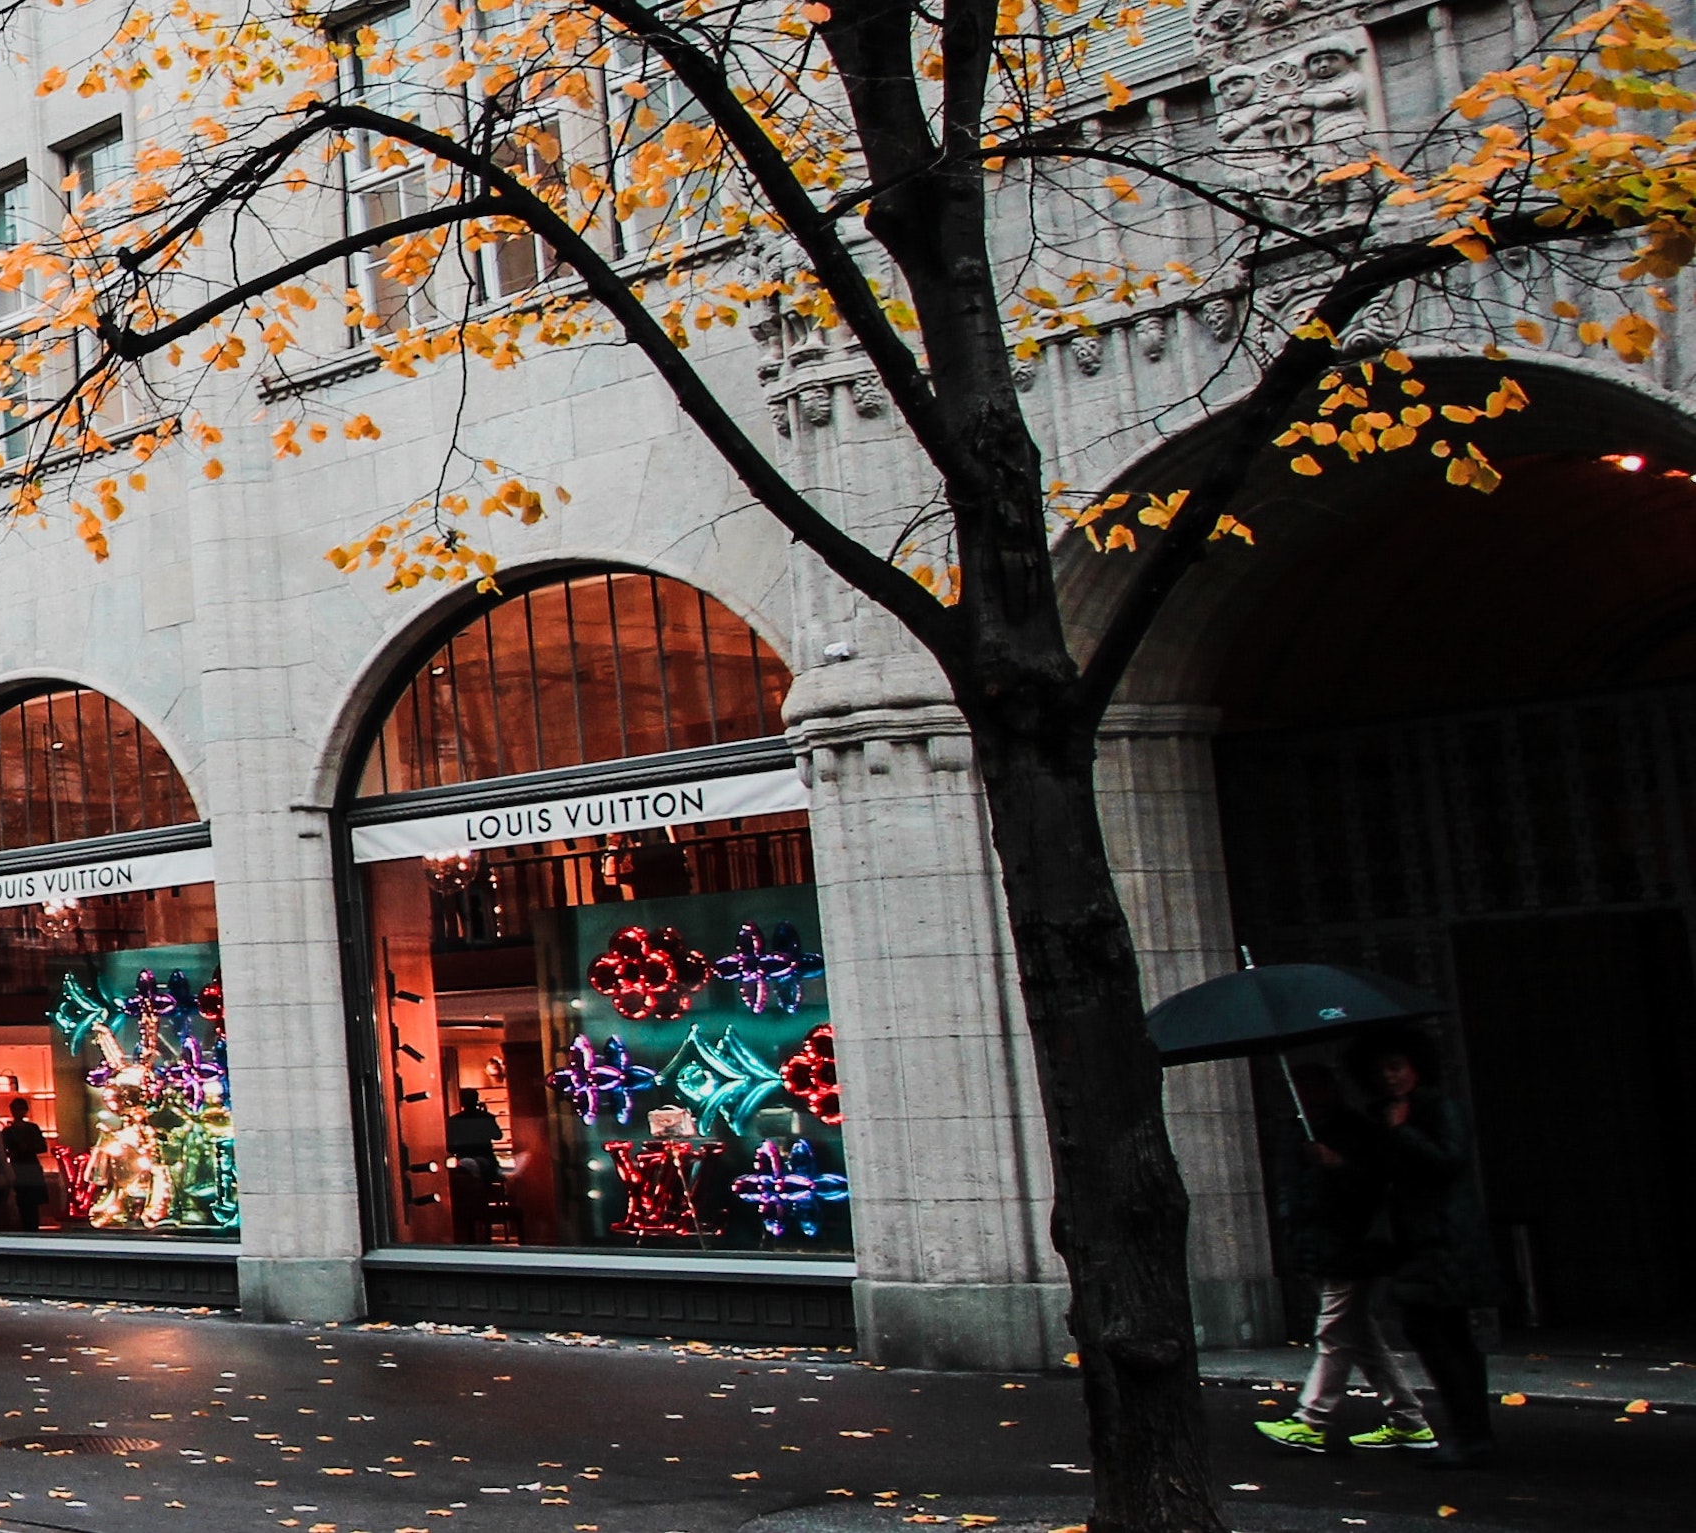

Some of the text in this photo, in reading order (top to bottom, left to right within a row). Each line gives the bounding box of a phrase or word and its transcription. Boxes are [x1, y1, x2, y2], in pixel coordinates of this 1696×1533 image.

[467, 788, 704, 841] LOUIS VUITTON
[44, 864, 133, 893] VUITTON
